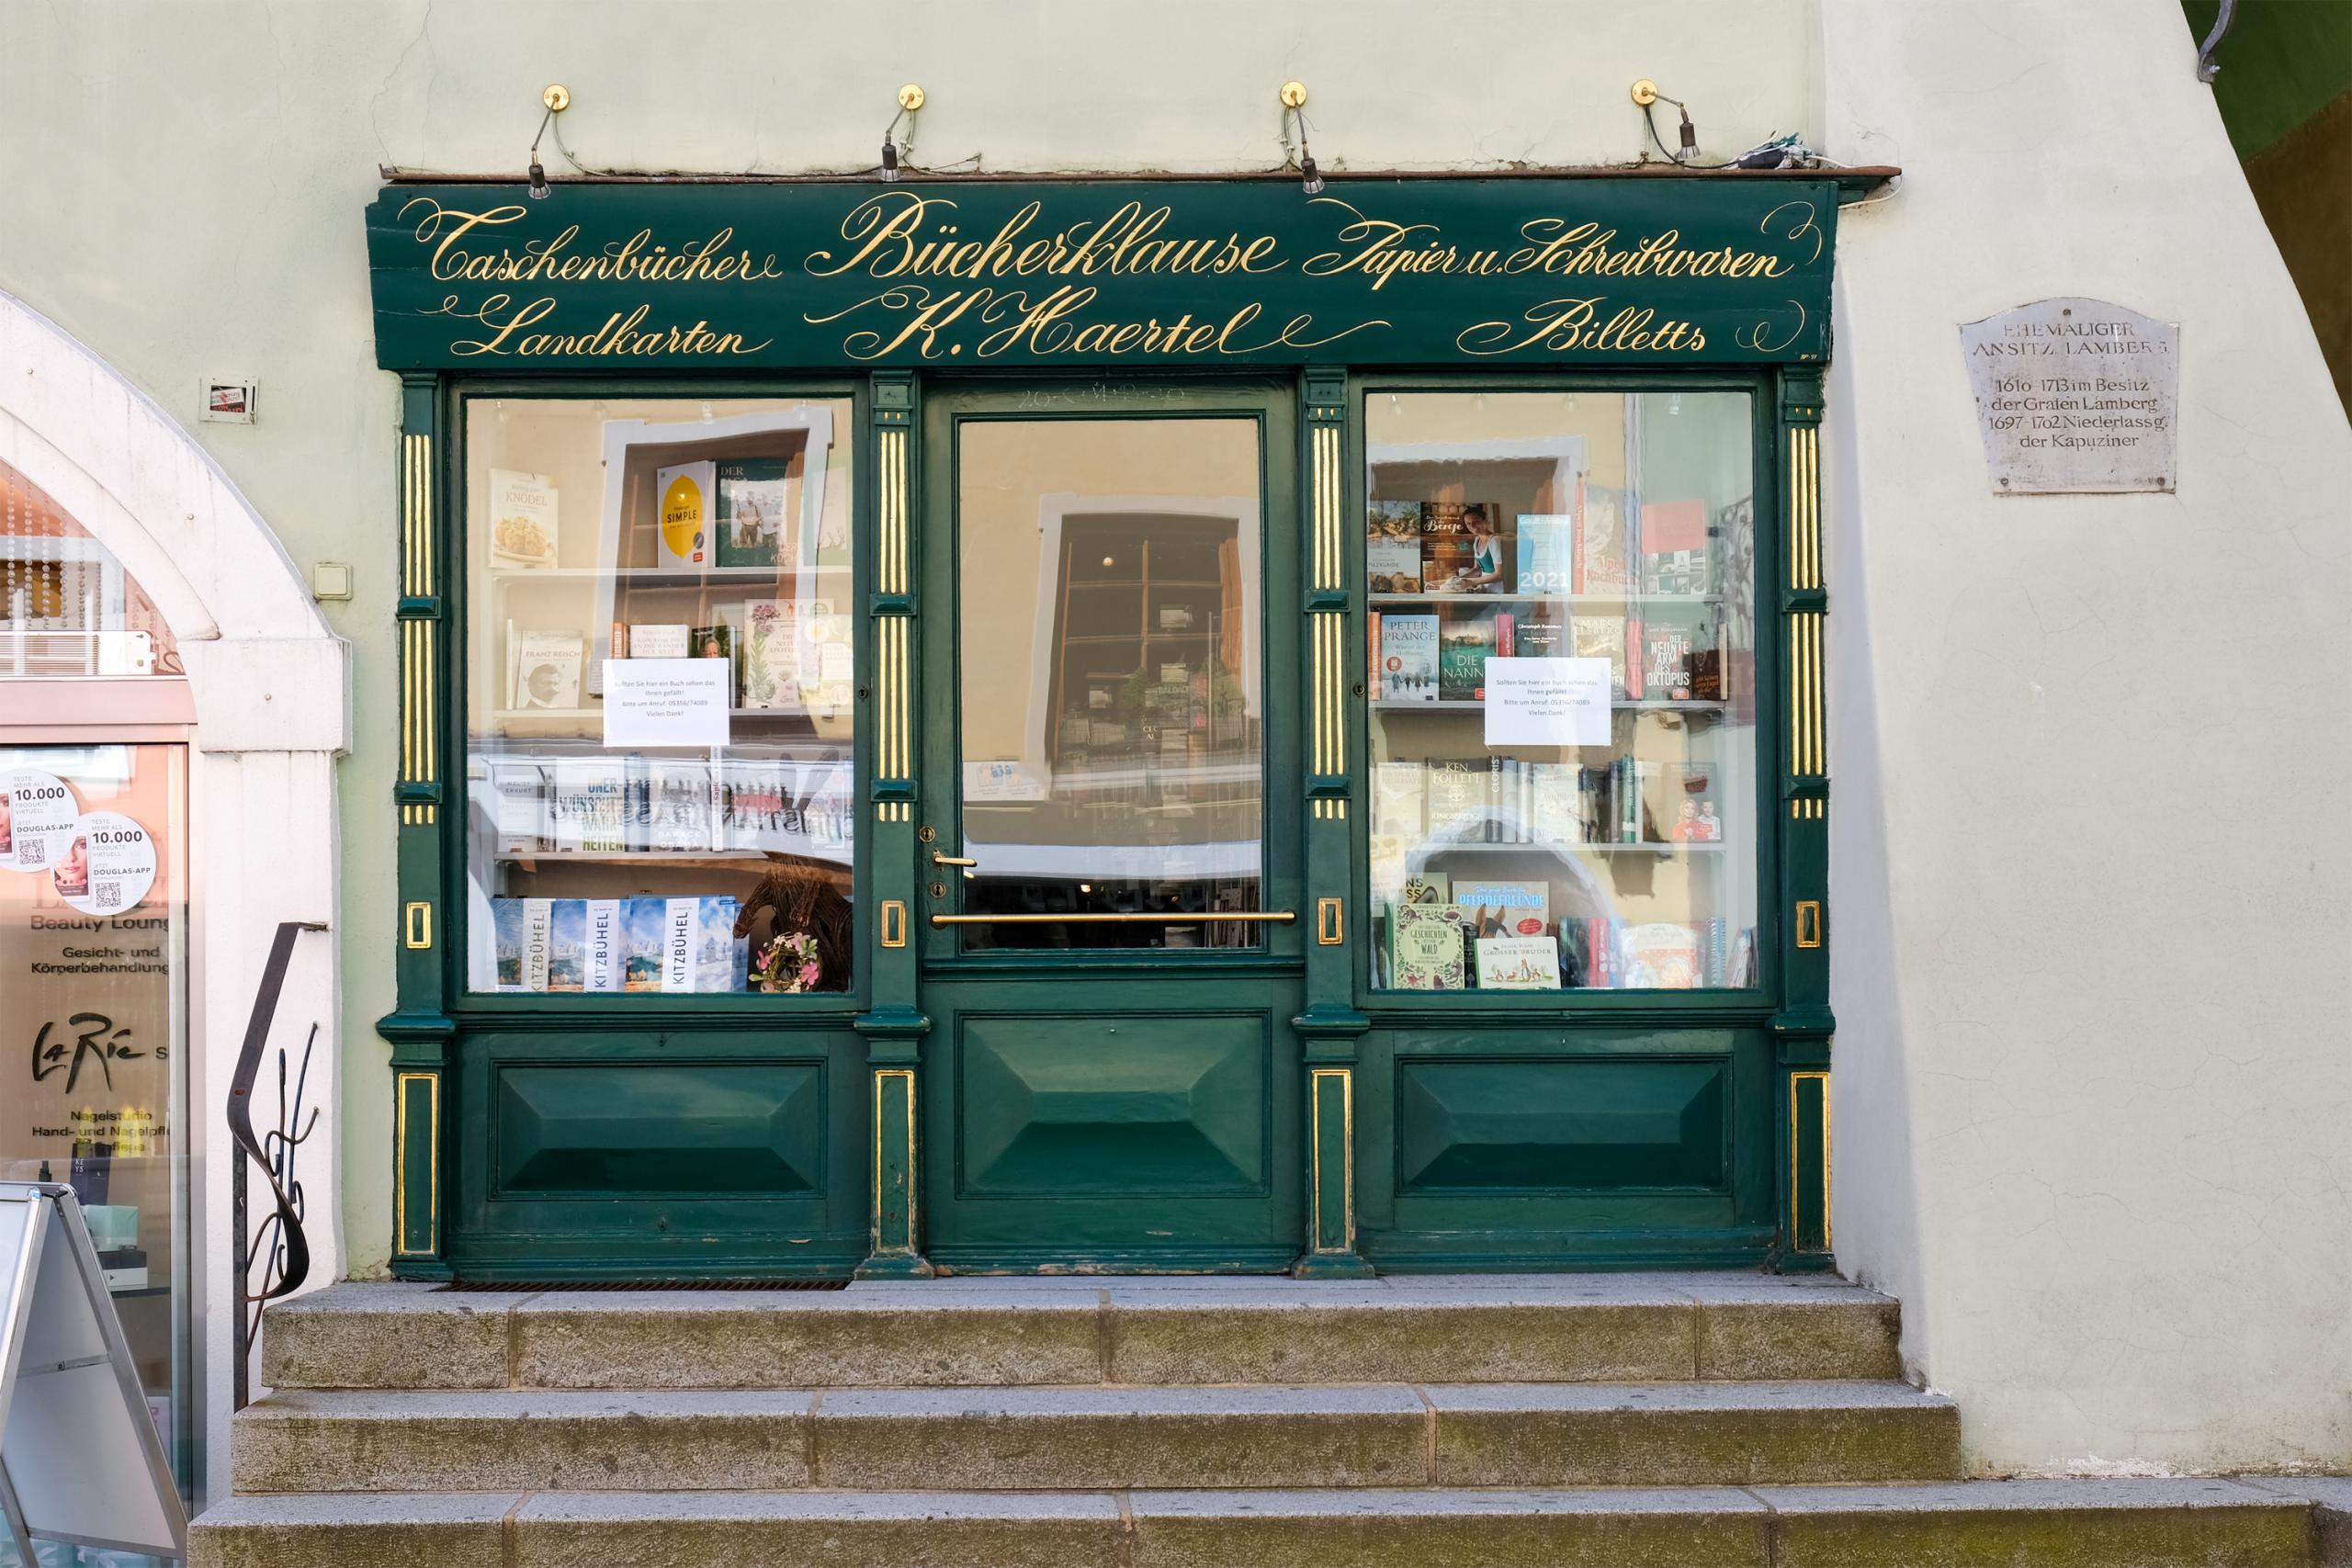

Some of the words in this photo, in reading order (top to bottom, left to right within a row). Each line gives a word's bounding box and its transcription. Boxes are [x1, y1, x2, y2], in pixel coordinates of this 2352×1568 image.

[398, 197, 782, 281] Taschenbücher
[804, 191, 1290, 279] Bücherklause
[1302, 197, 1469, 291] Papier
[1469, 246, 1505, 276] u.
[1504, 219, 1794, 279] Schreibwaren
[415, 294, 773, 357] Landkarten
[979, 285, 1392, 356] Haertel
[1457, 296, 1706, 355] Billetts
[2004, 322, 2135, 337] EHEMALIGER
[1973, 342, 2055, 356] ANSITZ
[2066, 341, 2168, 355] LAMBERG
[2096, 378, 2150, 392] Besitz
[1991, 398, 2021, 412] der
[2083, 397, 2158, 413] Lamberg
[2019, 434, 2047, 448] der
[2052, 434, 2139, 452] Kapuziner
[720, 466, 743, 476] DER
[505, 491, 548, 506] KNÖDEL
[666, 509, 697, 524] SIMPLE
[1423, 520, 1464, 536] Berge
[1521, 571, 1568, 588] 2021
[1390, 621, 1430, 631] PETER
[1384, 631, 1436, 641] PRANGE
[526, 649, 551, 659] FRANZ
[553, 649, 581, 659] REISCH
[1651, 641, 1690, 655] NEUNTE
[1457, 655, 1478, 666] DIE
[1656, 652, 1677, 663] ARM
[636, 680, 645, 688] Sie
[1646, 671, 1690, 686] OKTOPUS
[1446, 762, 1468, 773] KEN
[15, 786, 65, 801] 10.000
[17, 823, 74, 833] DOUGLAS-APP
[92, 830, 142, 843] 10.000
[94, 867, 151, 875] DOUGLAS-APP
[30, 915, 104, 932] Beauty
[1410, 930, 1448, 939] GESCHICHTEN
[62, 947, 125, 958] Gesicht-
[130, 947, 160, 958] und
[593, 912, 609, 988] KITZBÜHEL
[672, 911, 688, 985] KITZBÜHEL
[1421, 944, 1438, 954] WALD
[71, 1111, 153, 1123] Nagelstudio
[32, 1126, 74, 1136] Hand-
[79, 1126, 105, 1136] und
